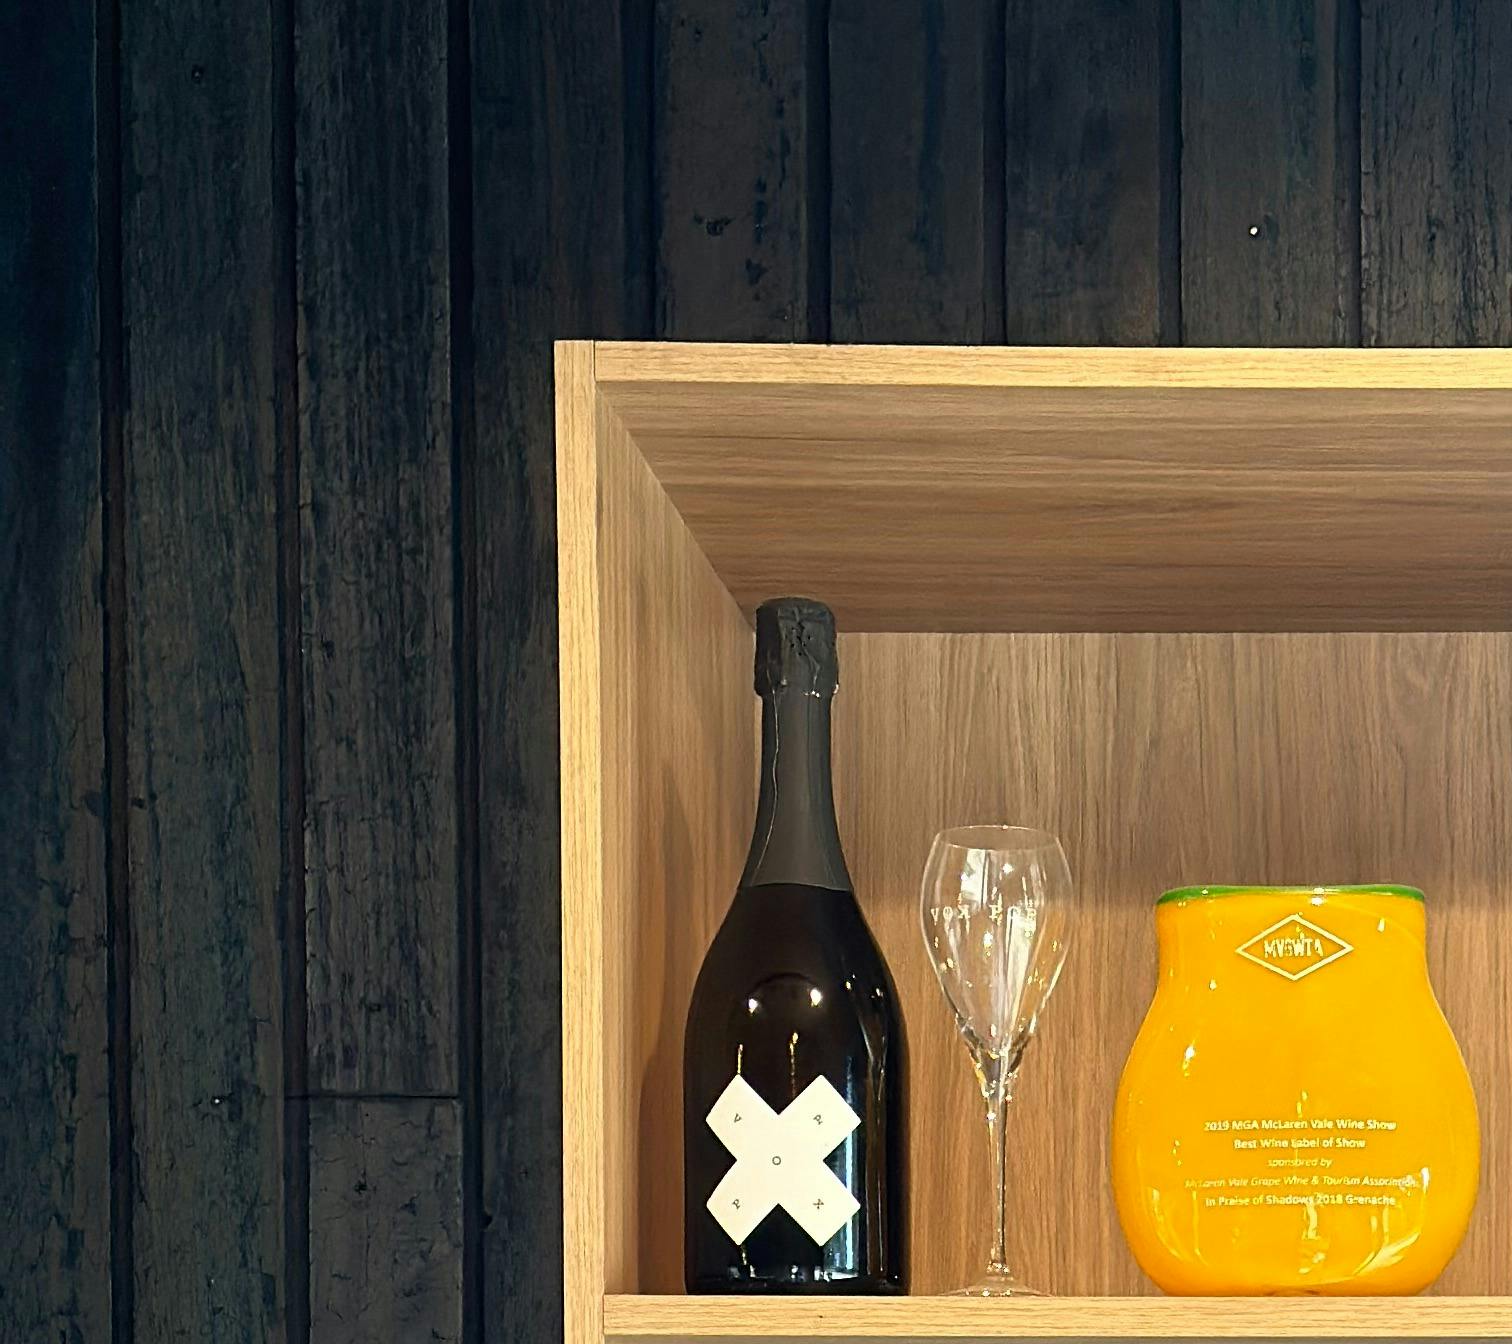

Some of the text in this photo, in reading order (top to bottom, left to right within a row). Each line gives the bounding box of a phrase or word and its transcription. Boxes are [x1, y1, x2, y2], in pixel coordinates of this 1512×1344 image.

[1232, 1120, 1259, 1130] MGA
[1261, 1119, 1308, 1130] McLaren
[1311, 1118, 1333, 1129] Vale
[1336, 1118, 1365, 1129] Wine
[1367, 1119, 1397, 1130] Show
[1234, 1139, 1257, 1149] Best
[1260, 1138, 1289, 1148] Wine
[1322, 1137, 1334, 1148] of
[1335, 1138, 1366, 1148] Show
[1320, 1157, 1333, 1169] by
[1283, 1176, 1309, 1186] Wine
[1205, 1193, 1396, 1207] In Praise of Shadows 2018 Grenache
